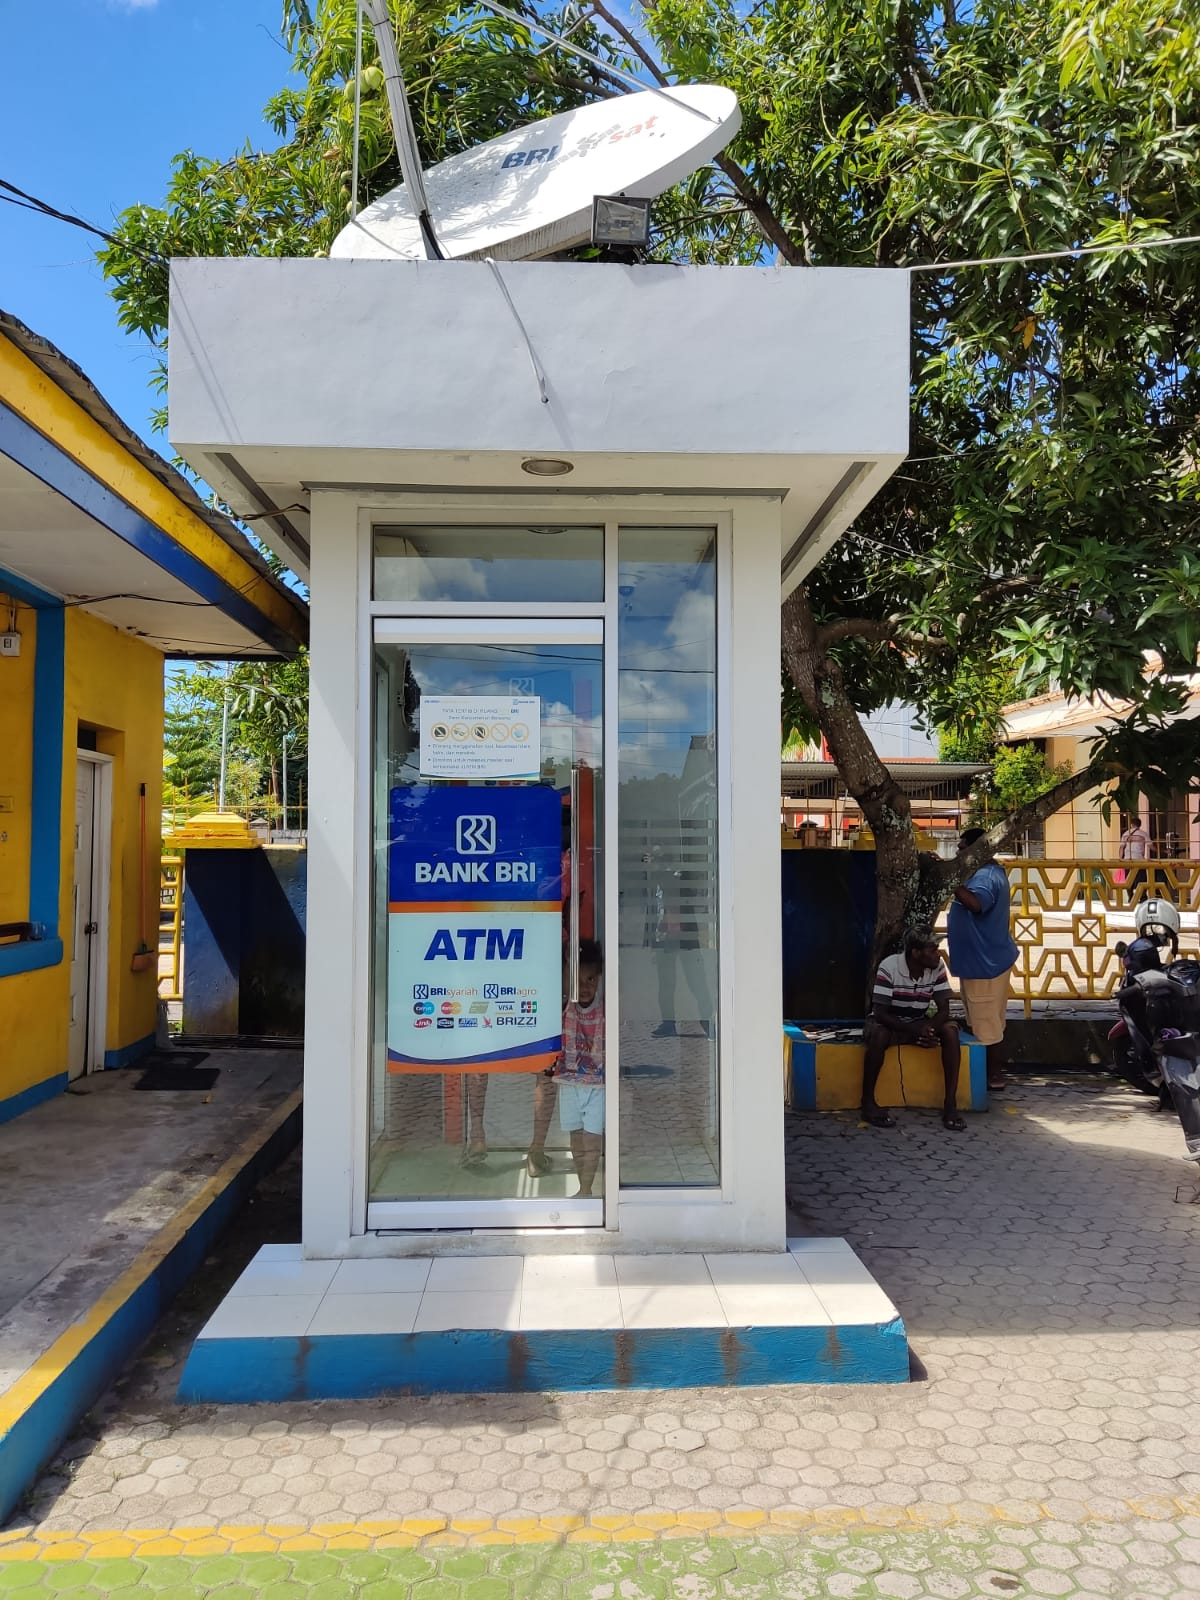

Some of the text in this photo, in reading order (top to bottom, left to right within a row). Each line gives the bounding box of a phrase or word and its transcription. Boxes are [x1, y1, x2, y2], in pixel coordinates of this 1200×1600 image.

[501, 145, 560, 169] BRI
[415, 862, 536, 883] BANK BRI
[424, 929, 524, 961] ATM
[496, 1016, 537, 1026] BRIZZI
